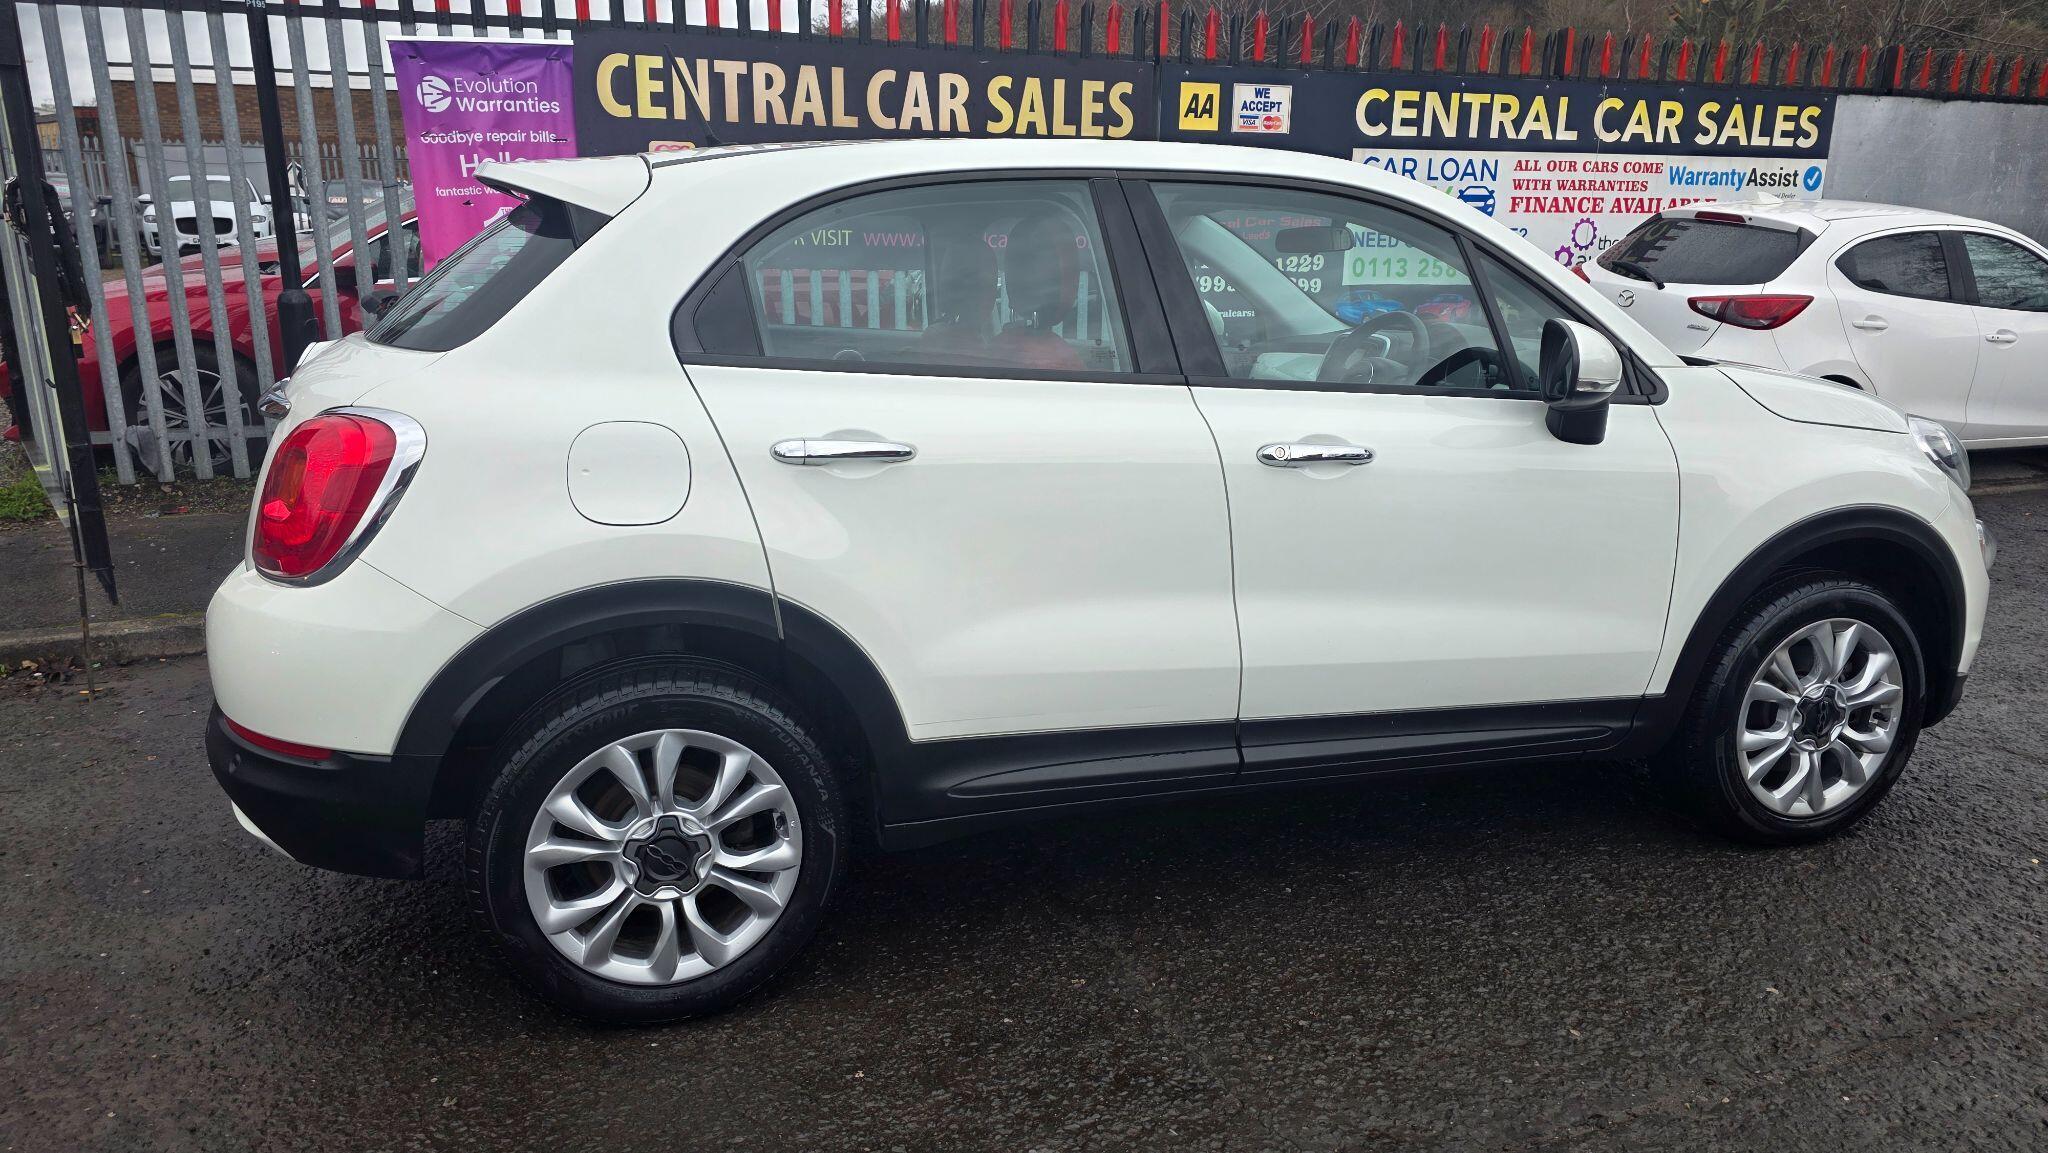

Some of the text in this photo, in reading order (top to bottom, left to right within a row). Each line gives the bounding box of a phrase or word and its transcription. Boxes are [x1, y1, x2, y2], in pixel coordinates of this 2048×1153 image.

[454, 77, 538, 94] Evolution
[1254, 87, 1271, 99] WE
[596, 53, 1134, 139] CENTRAL CAR SALES
[456, 97, 561, 114] Warranties
[1183, 93, 1214, 119] AA
[1241, 100, 1283, 112] ACCEPT
[1355, 88, 1822, 148] CENTRAL CAR SALES
[420, 130, 484, 146] Goodbye
[486, 129, 527, 146] repair
[1426, 157, 1499, 182] LOAN
[1513, 159, 1664, 174] ALL OUR CARS COME
[435, 185, 483, 197] fantastic
[1512, 178, 1649, 192] WITH WARRANTIES
[1508, 196, 1605, 214] FINANCE
[1245, 216, 1275, 228] Car
[1279, 216, 1322, 228] Sales
[811, 229, 853, 246] VISIT
[1353, 231, 1399, 248] NEED
[1352, 256, 1407, 278] 0113
[766, 723, 830, 802] TURANZA
